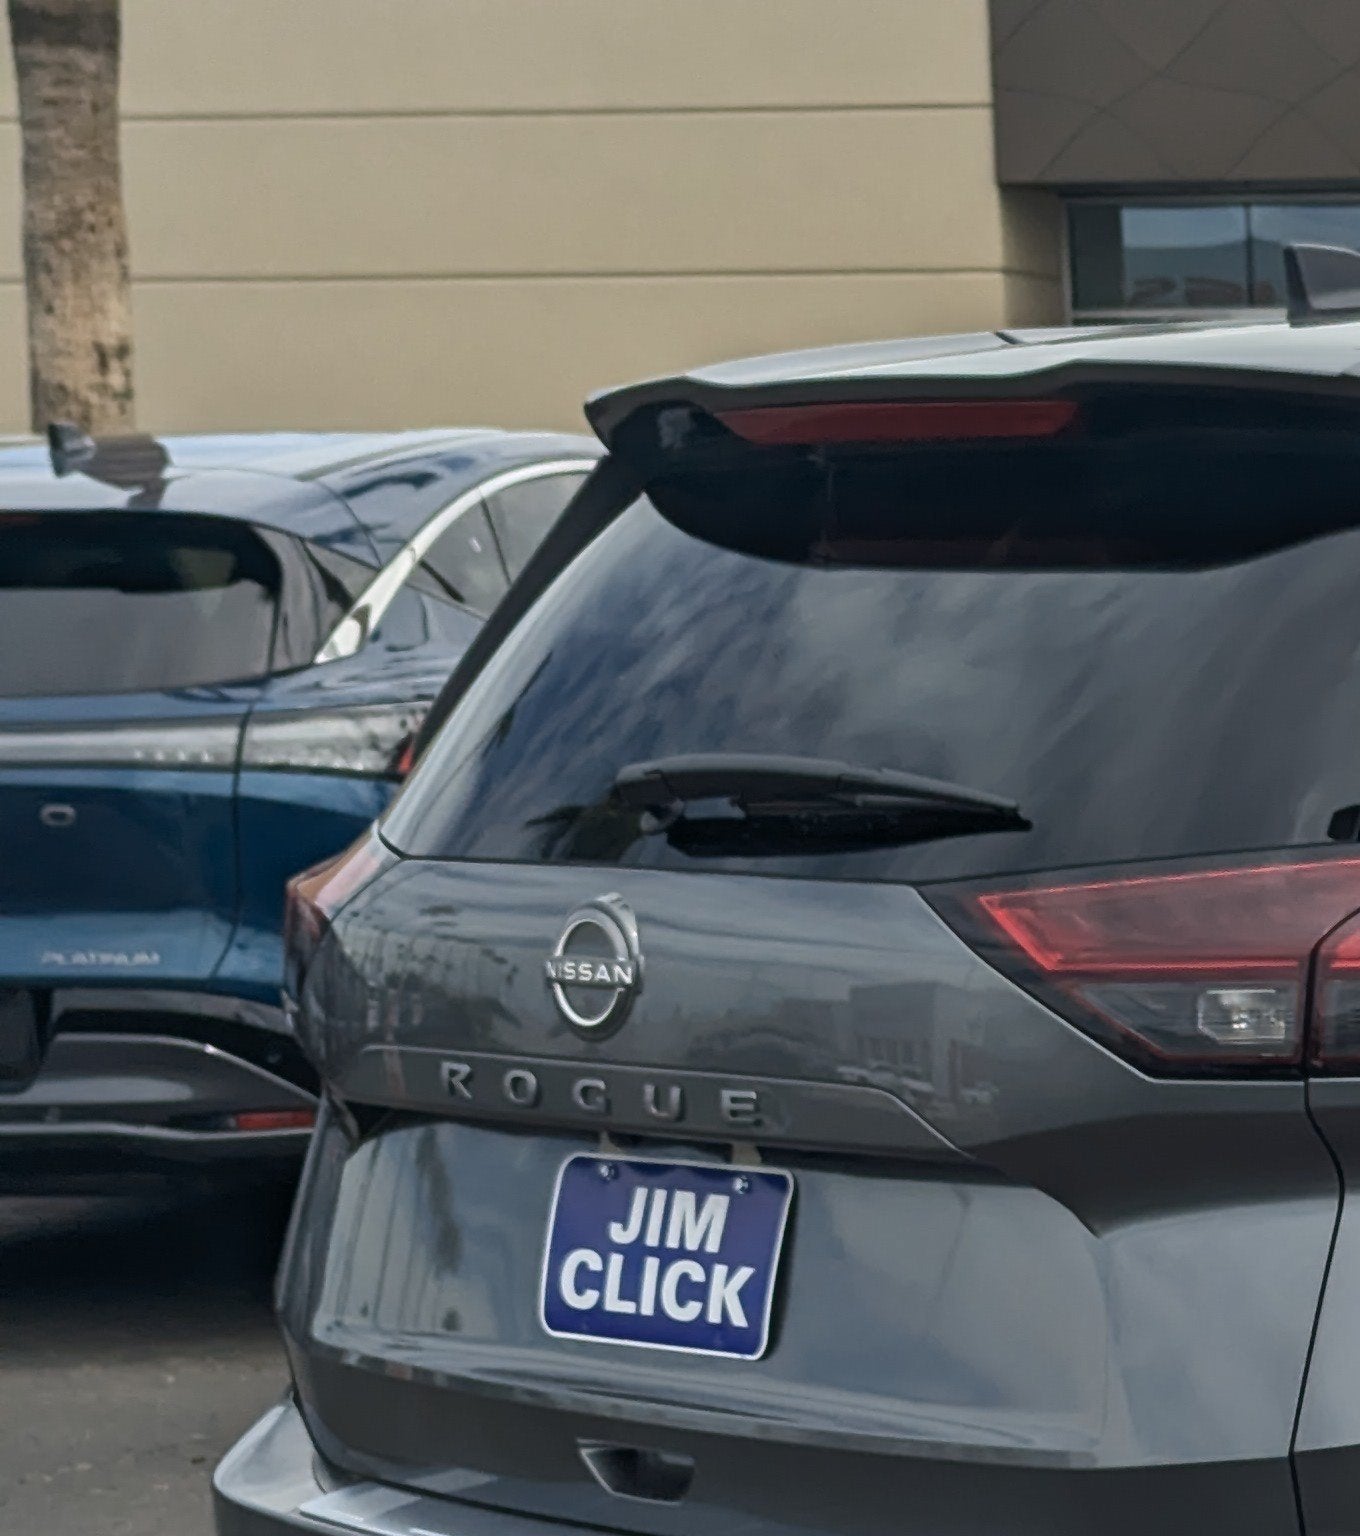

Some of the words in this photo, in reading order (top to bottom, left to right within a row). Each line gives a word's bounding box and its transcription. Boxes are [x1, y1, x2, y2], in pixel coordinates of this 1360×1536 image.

[545, 959, 633, 985] NISSAN
[440, 1060, 763, 1126] ROGUE
[608, 1186, 730, 1254] JIM
[558, 1247, 756, 1329] CLICK
